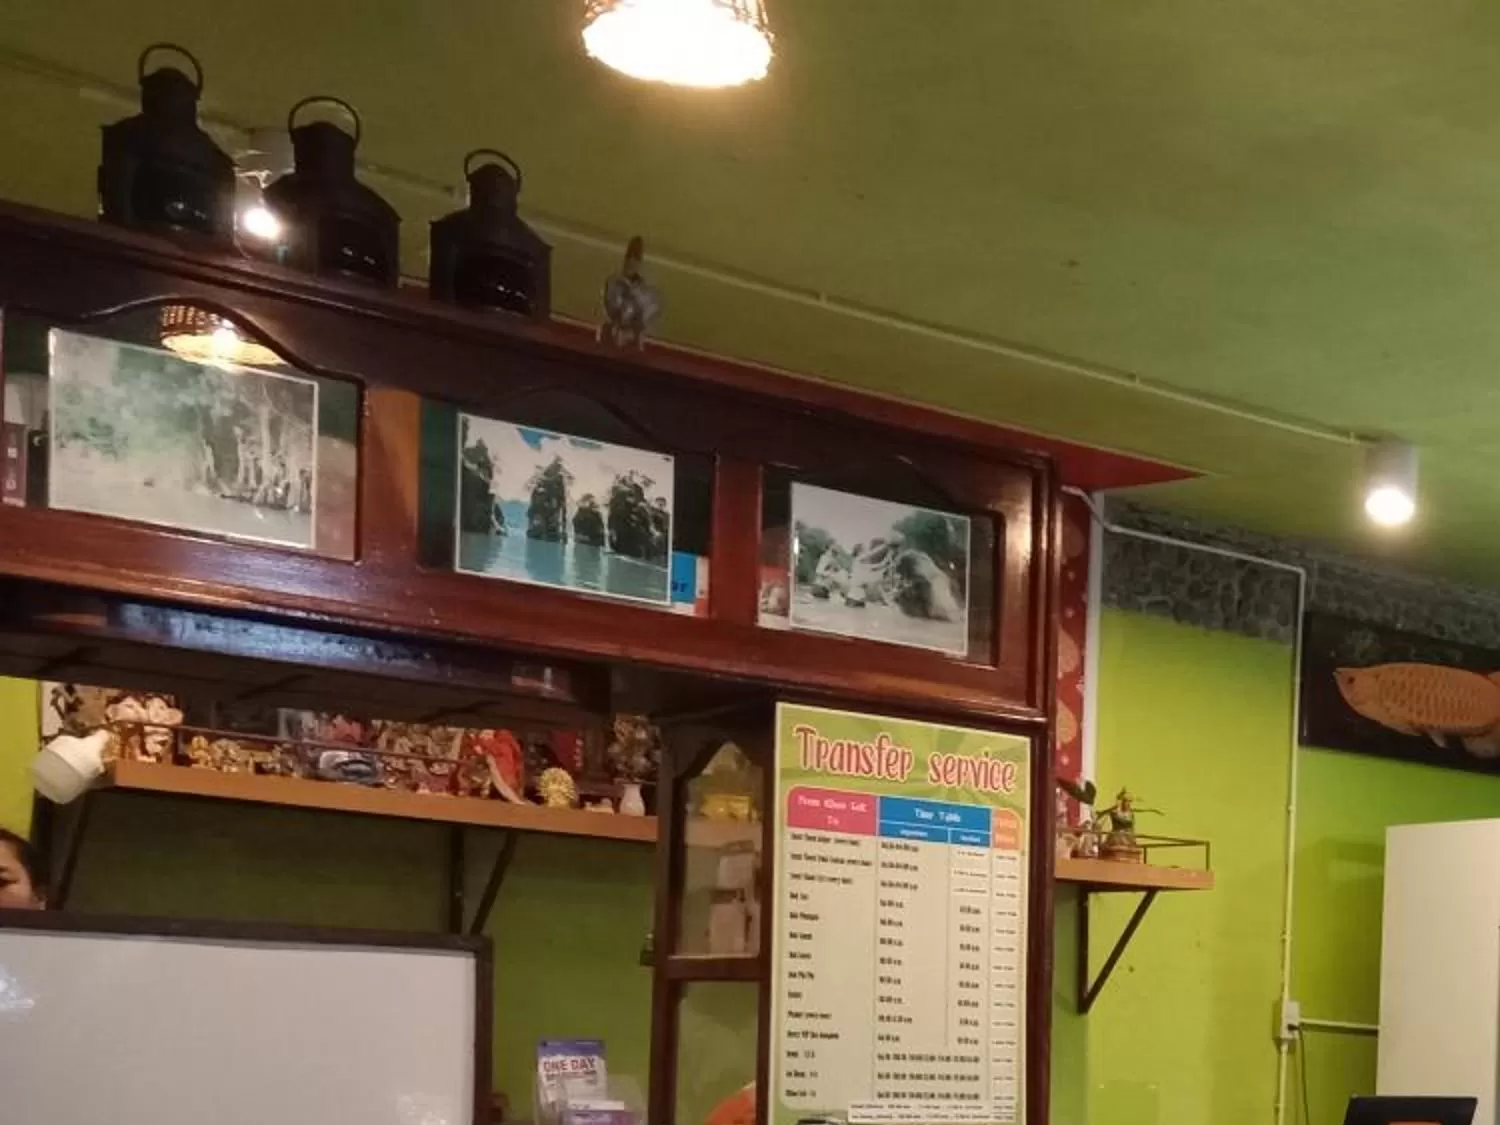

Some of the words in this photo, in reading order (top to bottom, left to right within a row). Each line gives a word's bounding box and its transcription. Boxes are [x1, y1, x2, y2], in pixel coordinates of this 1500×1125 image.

[794, 726, 913, 780] Transfer
[929, 752, 1017, 792] service
[571, 1057, 595, 1070] DAY
